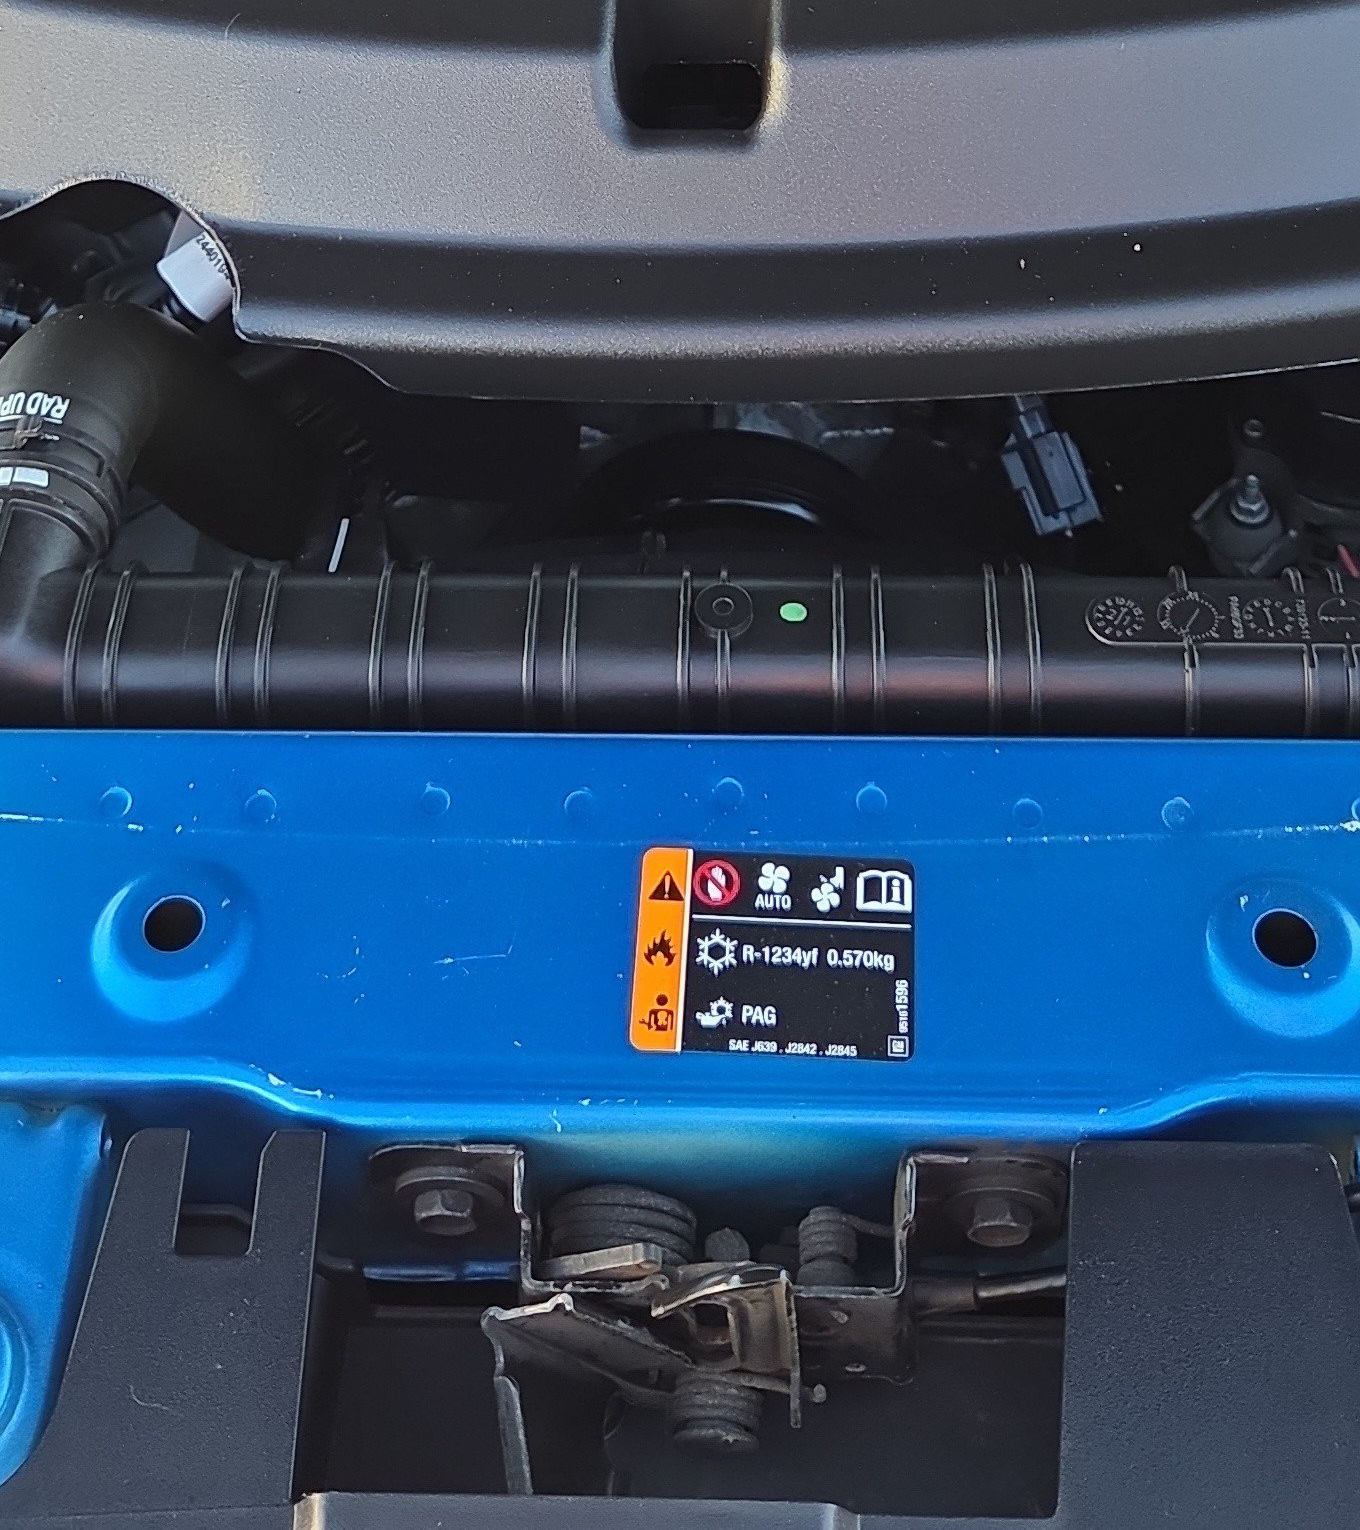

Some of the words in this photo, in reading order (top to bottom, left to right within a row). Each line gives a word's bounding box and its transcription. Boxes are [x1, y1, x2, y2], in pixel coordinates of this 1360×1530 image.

[25, 391, 71, 420] RAD
[754, 893, 792, 910] AUTO
[742, 947, 819, 968] R-1234yf
[826, 948, 895, 972] 0.570kg
[741, 1005, 777, 1026] PAG
[728, 1038, 750, 1052] SAE
